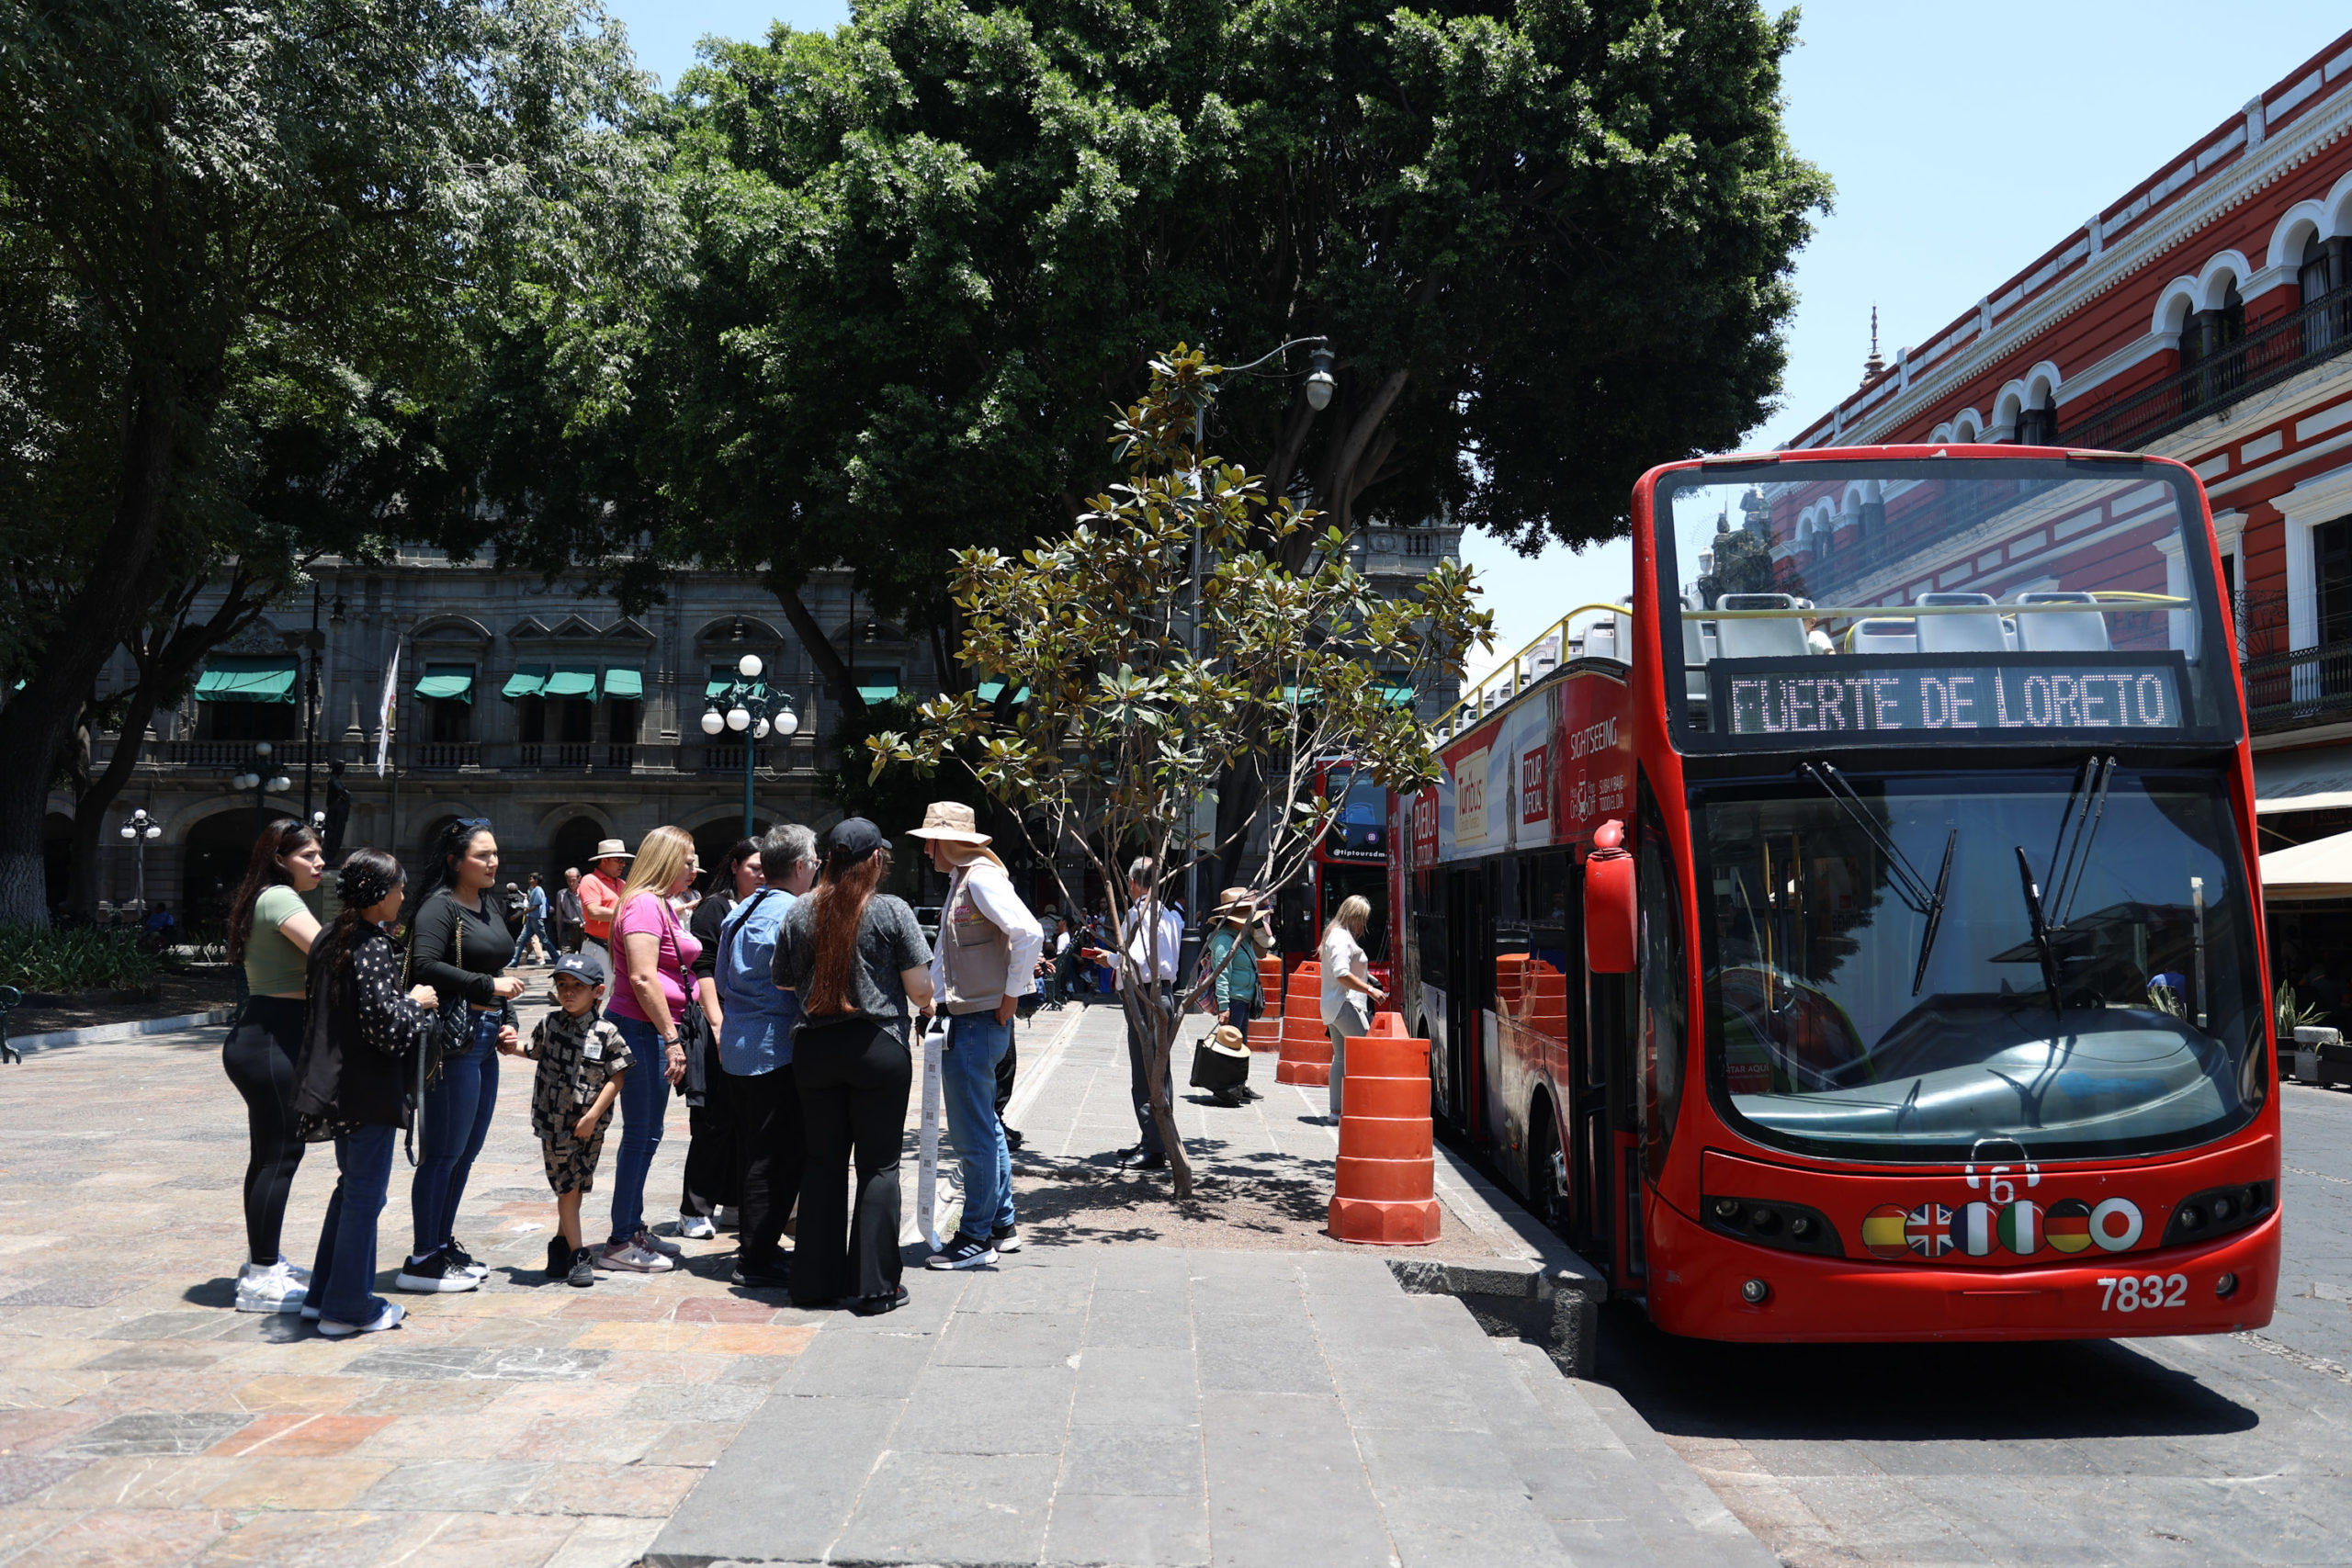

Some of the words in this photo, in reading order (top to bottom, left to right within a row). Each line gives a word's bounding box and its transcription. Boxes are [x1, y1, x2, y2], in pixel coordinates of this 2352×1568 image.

[1732, 679, 1902, 733] FUERTE
[1920, 677, 1978, 729] DE
[1995, 673, 2165, 728] LORETO
[1570, 716, 1618, 761] SIGHTSEEING
[1523, 754, 1543, 788] TOUR
[1458, 769, 1482, 816] Turibus
[1524, 788, 1544, 816] OFICIAL
[1414, 797, 1437, 841] PUEBLA
[1989, 1166, 2015, 1204] 6
[2098, 1273, 2188, 1313] 7832
